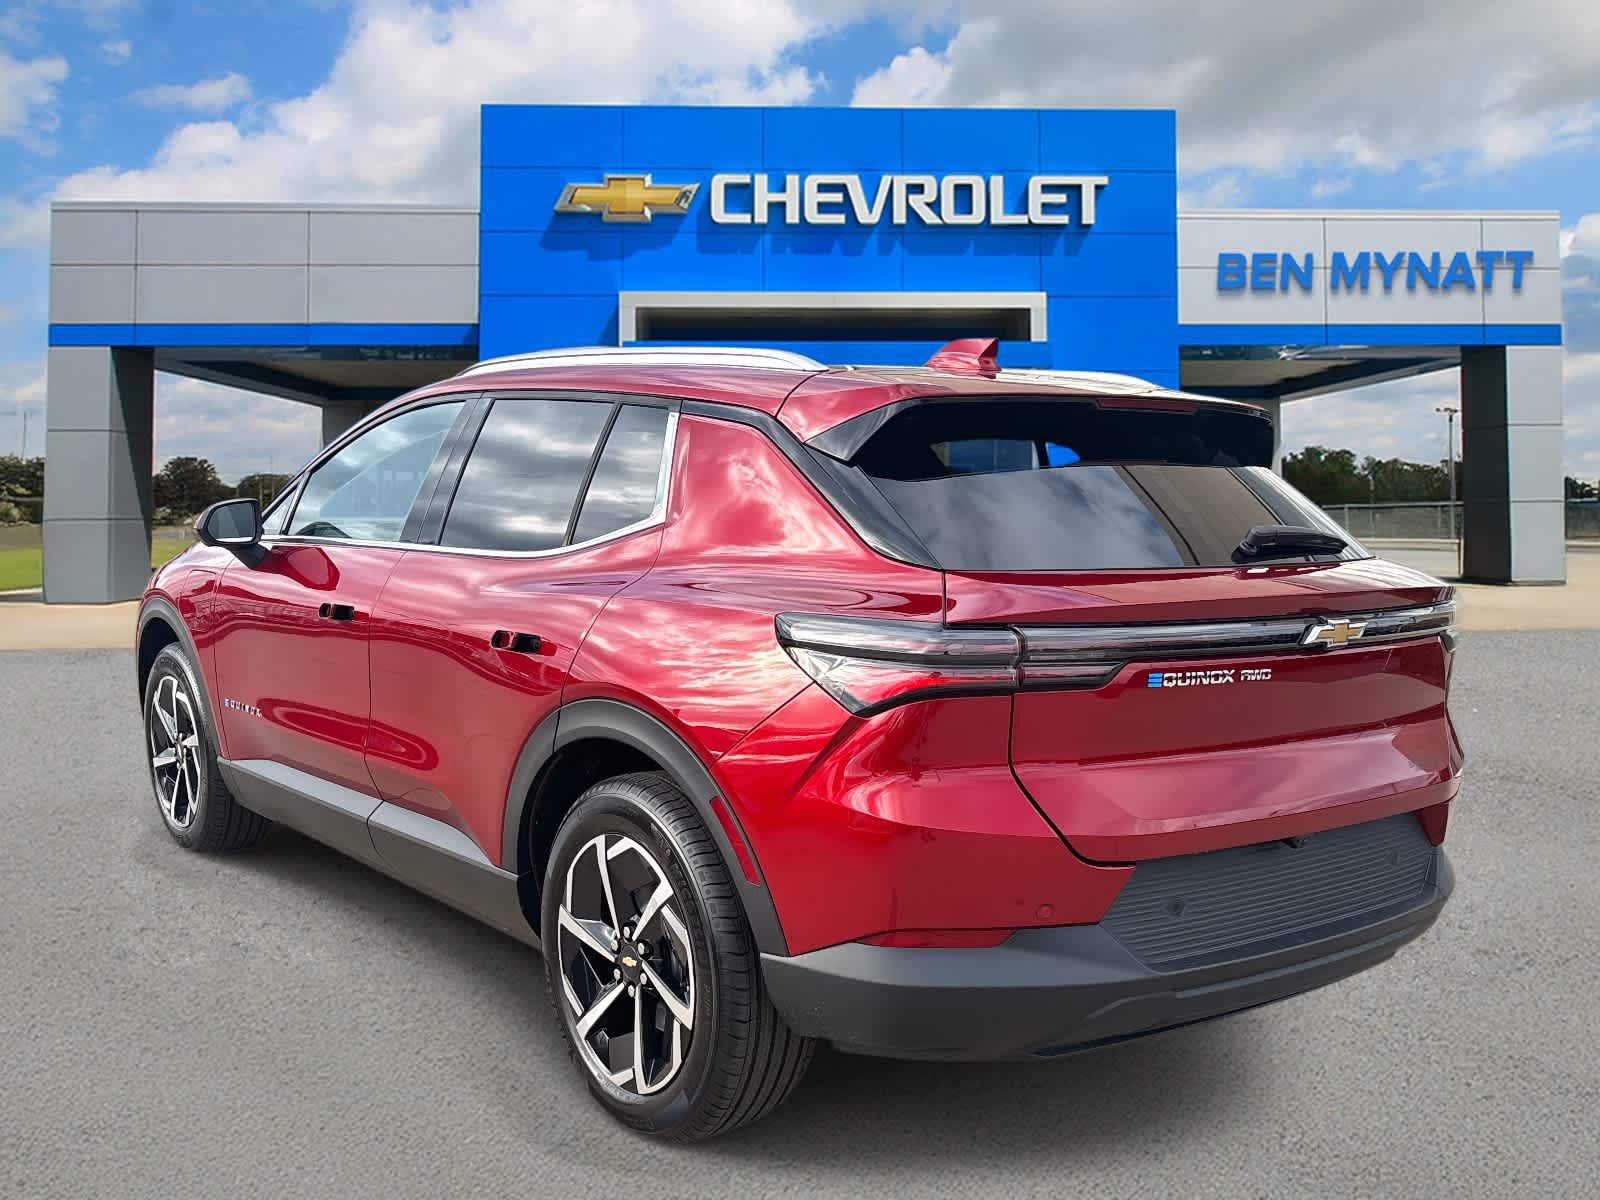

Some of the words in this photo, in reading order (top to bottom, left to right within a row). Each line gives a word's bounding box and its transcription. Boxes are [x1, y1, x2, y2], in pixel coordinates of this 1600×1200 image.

[710, 173, 1110, 226] CHEVROLET
[1216, 252, 1314, 291] BEN
[1329, 250, 1535, 290] MYNATT
[1147, 669, 1235, 688] EQUINOX
[1240, 668, 1272, 681] AWD
